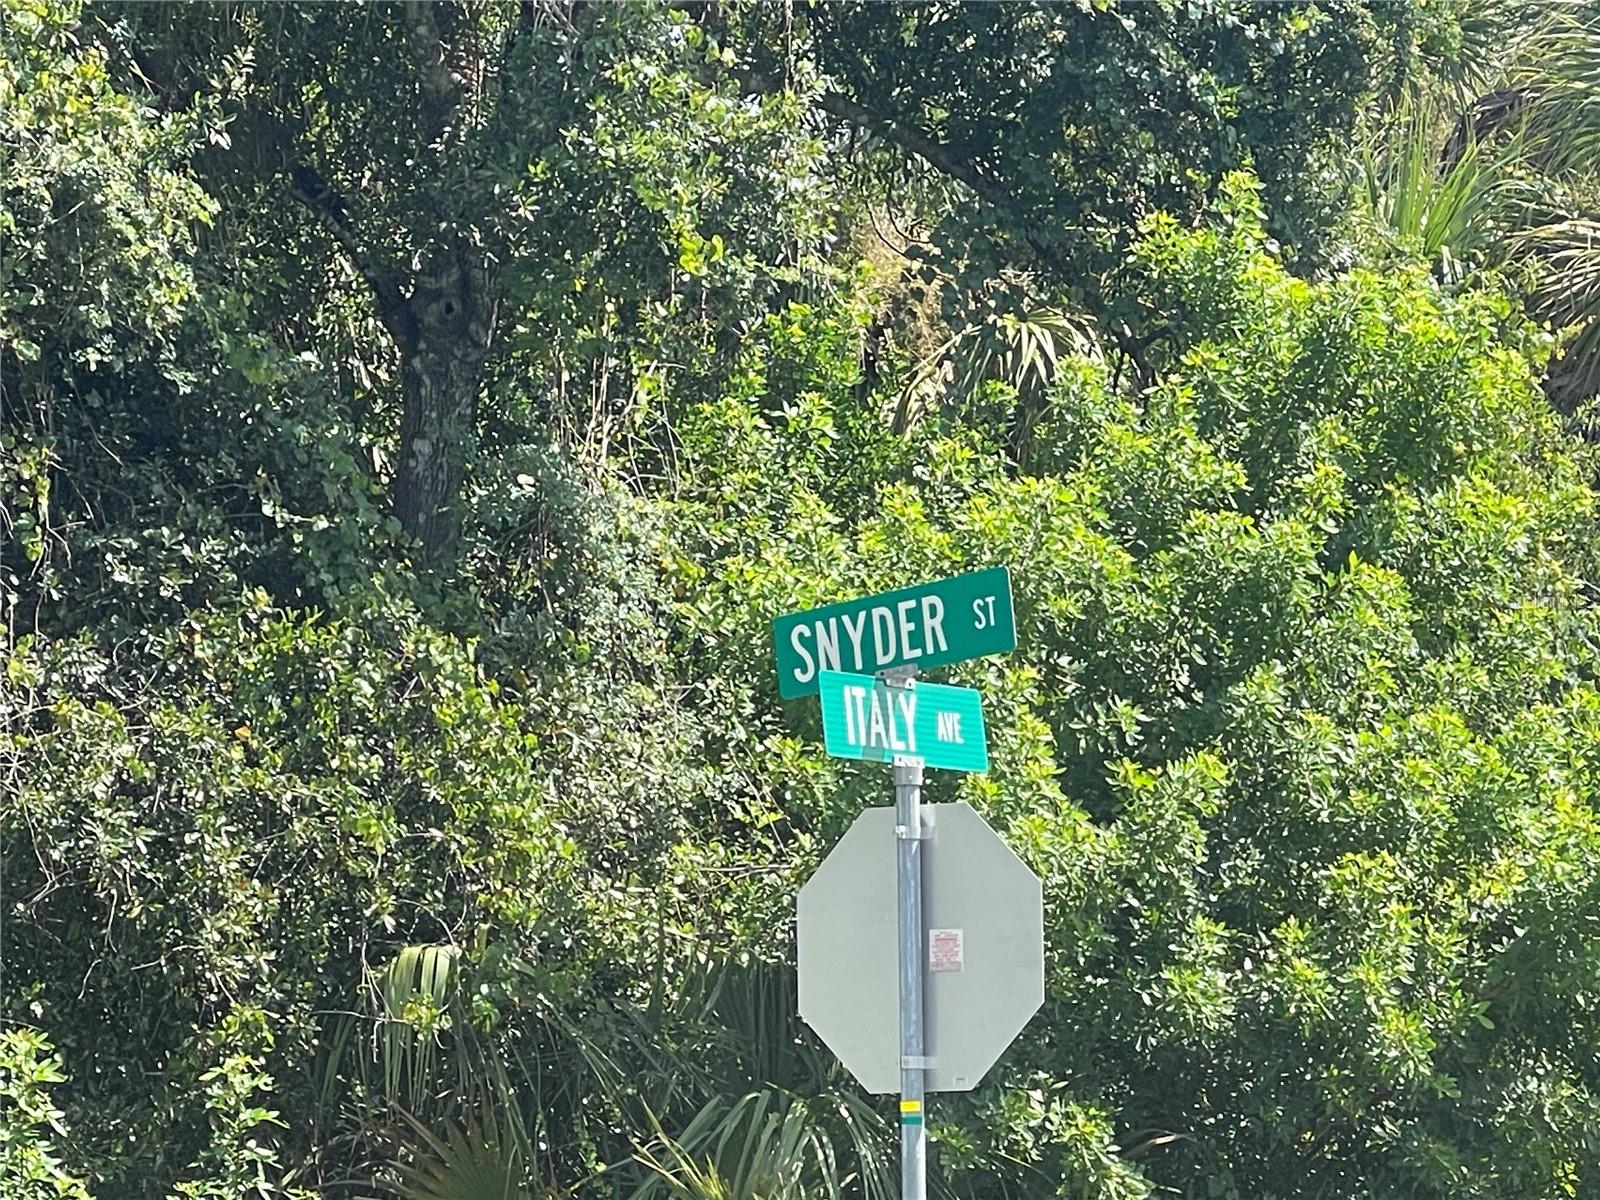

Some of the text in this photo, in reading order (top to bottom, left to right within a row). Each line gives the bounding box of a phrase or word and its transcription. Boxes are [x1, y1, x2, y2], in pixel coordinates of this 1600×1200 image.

[790, 595, 996, 683] SNYDER ST
[843, 685, 965, 751] ITALY AVE
